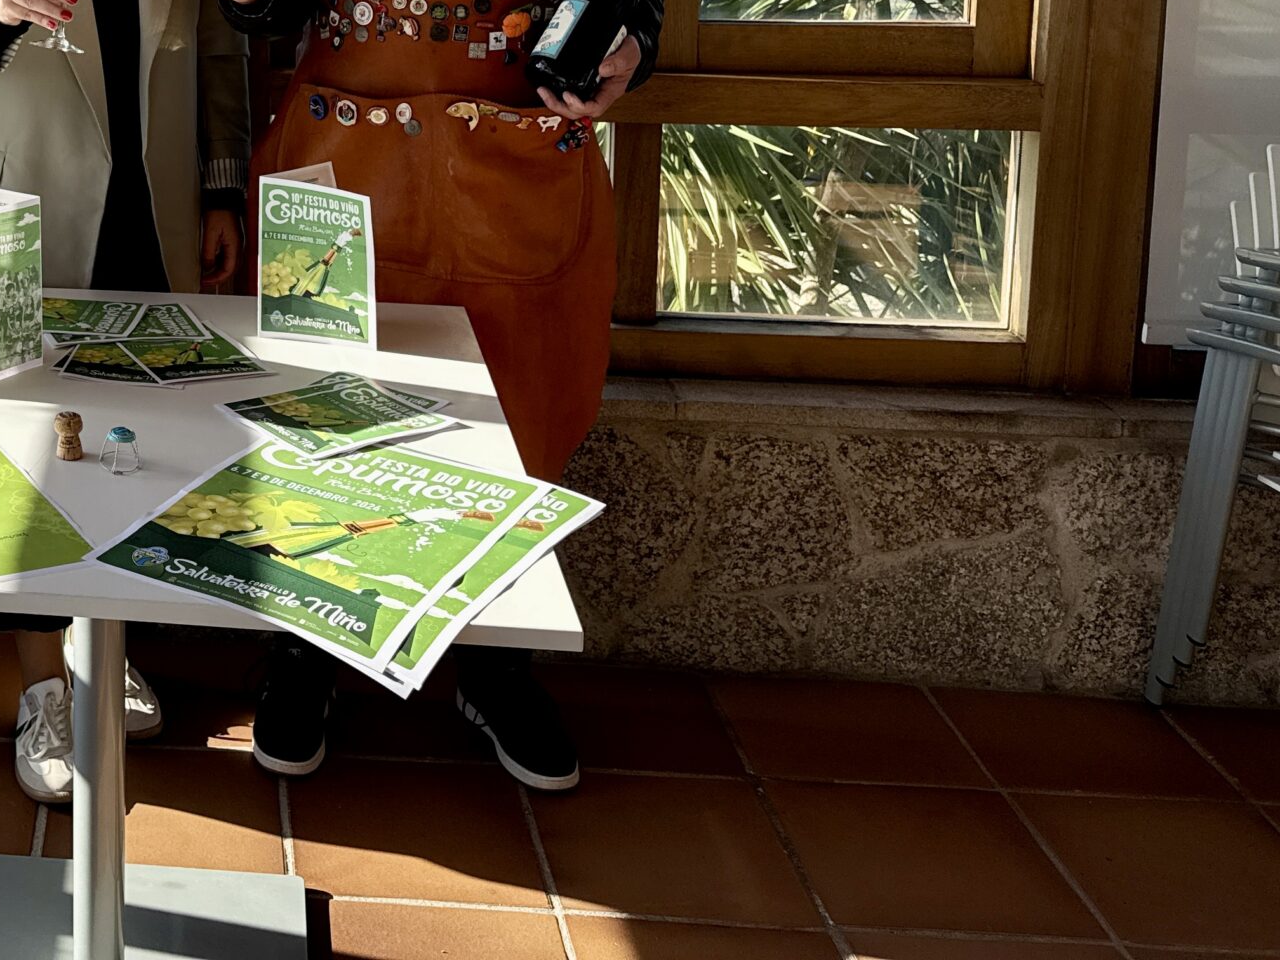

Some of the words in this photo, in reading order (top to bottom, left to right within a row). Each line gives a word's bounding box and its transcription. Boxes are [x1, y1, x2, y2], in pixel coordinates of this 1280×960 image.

[265, 189, 361, 229] Espumoso
[304, 194, 328, 208] FESTA
[329, 199, 339, 210] DO
[340, 200, 359, 215] VIÑO
[269, 477, 286, 487] DE
[351, 499, 381, 512] 2024
[369, 456, 428, 479] FESTA
[431, 471, 463, 487] DO
[464, 478, 517, 500] VIÑO
[538, 493, 568, 512] ÑO
[248, 580, 289, 595] CONCELLO
[275, 592, 301, 608] de
[304, 596, 367, 632] Miño
